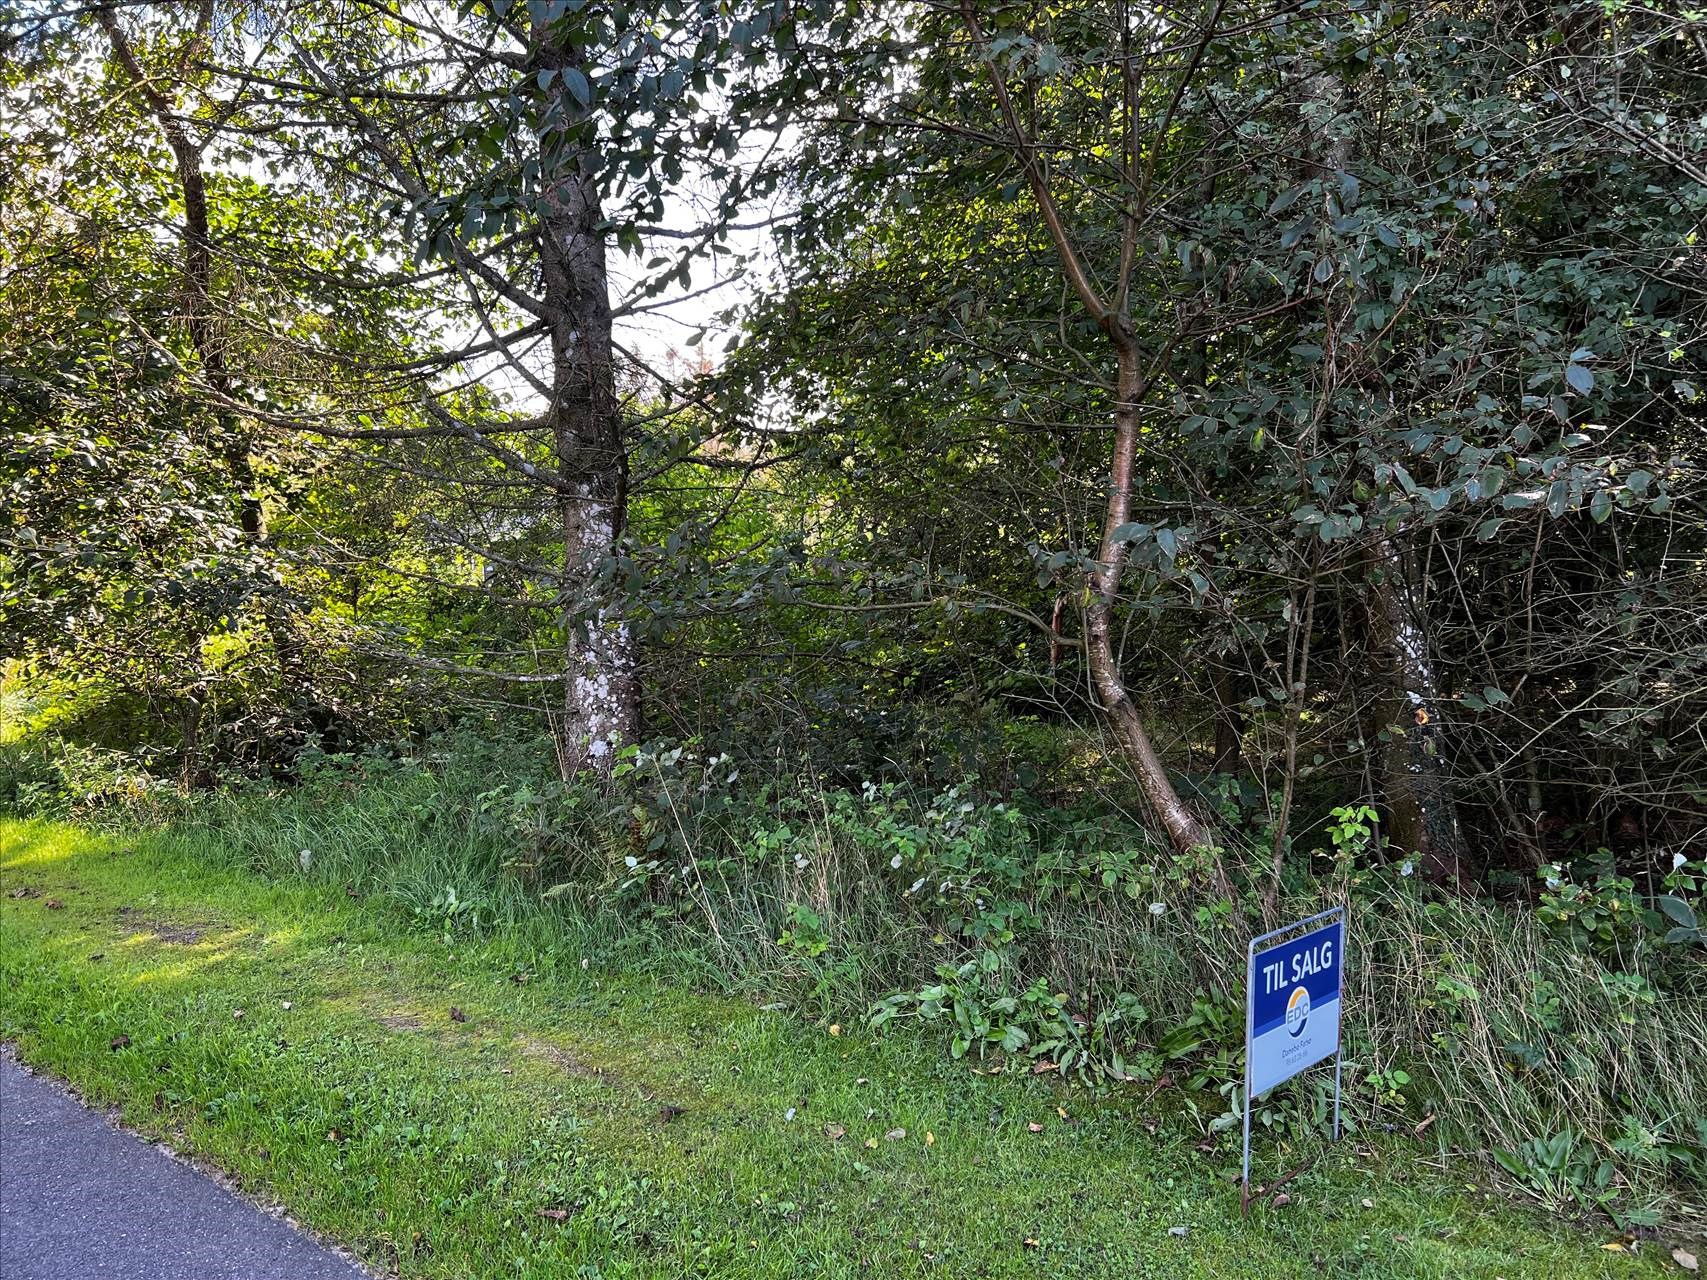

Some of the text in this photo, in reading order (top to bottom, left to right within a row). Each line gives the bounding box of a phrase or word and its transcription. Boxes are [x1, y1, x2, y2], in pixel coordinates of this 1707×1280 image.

[1263, 941, 1332, 994] TIL SALG
[1287, 1003, 1309, 1024] EDC
